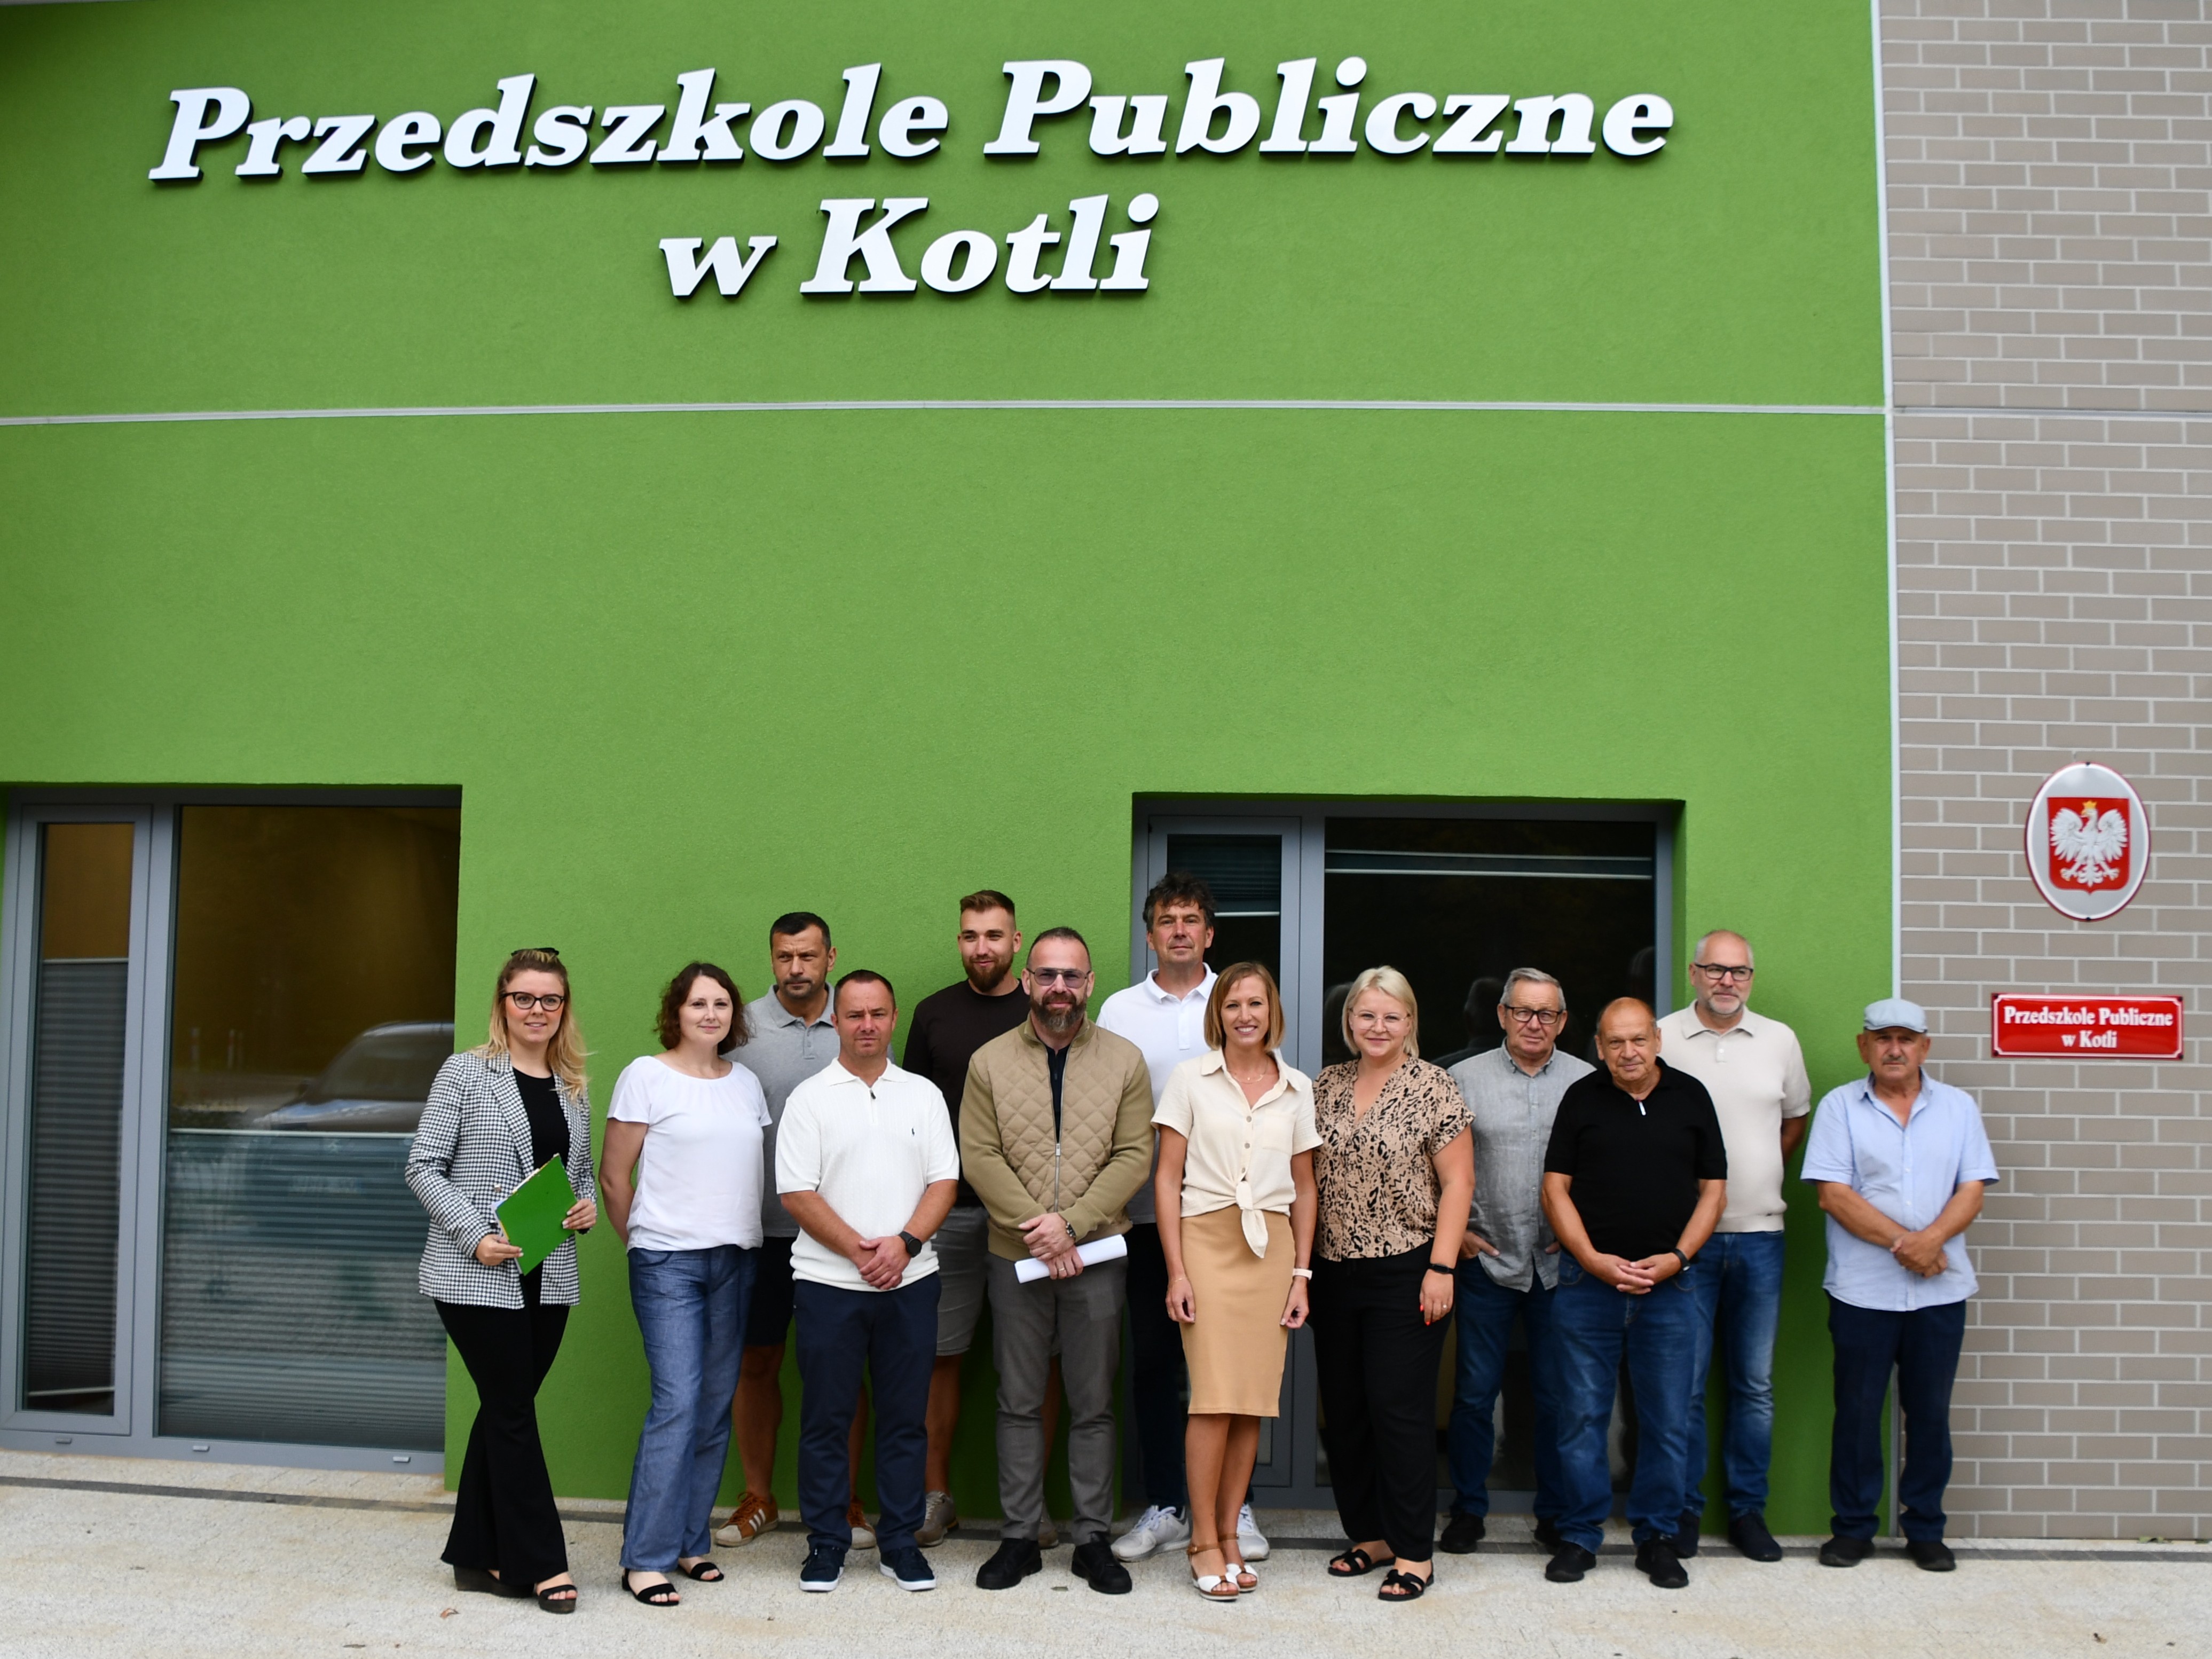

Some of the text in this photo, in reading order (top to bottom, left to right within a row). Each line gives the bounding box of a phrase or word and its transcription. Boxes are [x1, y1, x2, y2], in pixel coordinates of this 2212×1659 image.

[149, 57, 1674, 179] Przedszkole Publiczne
[659, 193, 1159, 296] w Kotli
[2004, 1005, 2173, 1026] Przedszkole Publiczne
[2061, 1030, 2117, 1048] w Kotli
